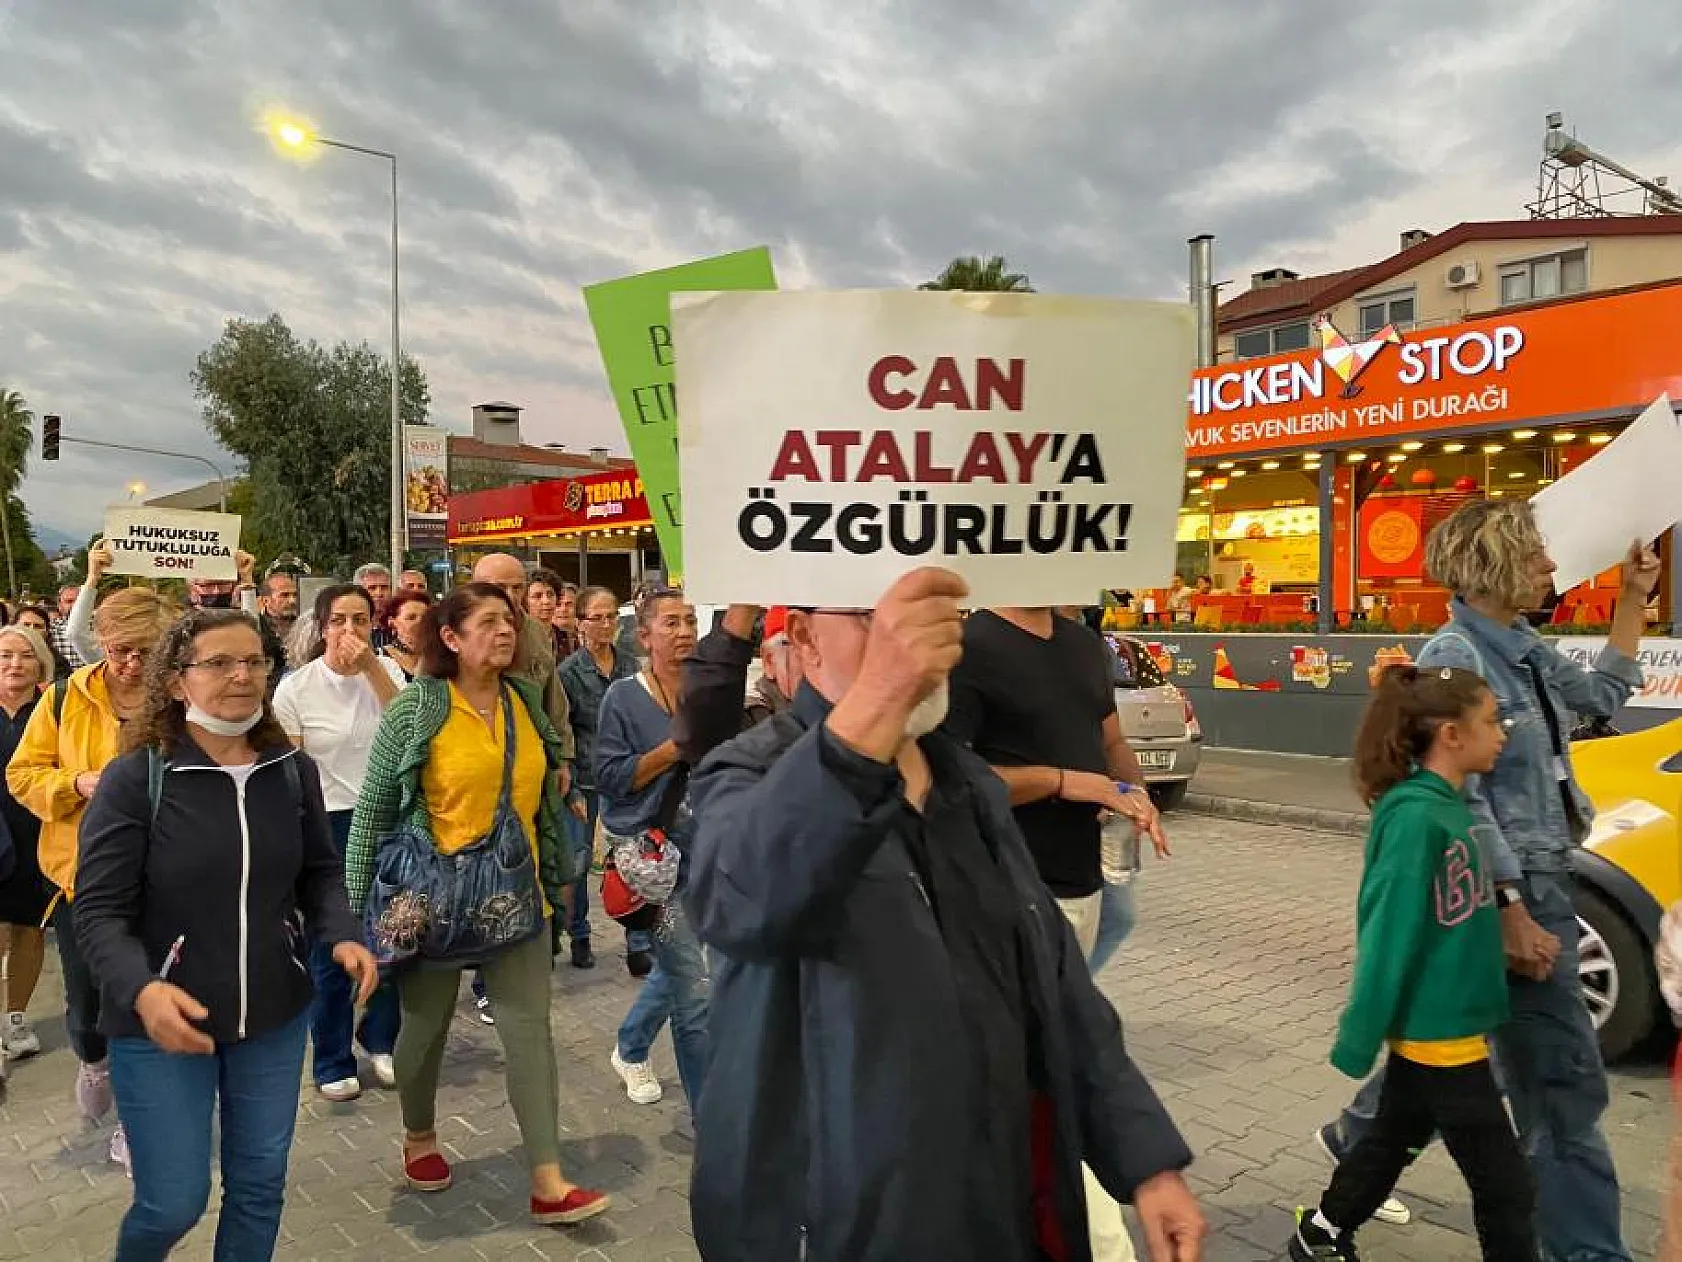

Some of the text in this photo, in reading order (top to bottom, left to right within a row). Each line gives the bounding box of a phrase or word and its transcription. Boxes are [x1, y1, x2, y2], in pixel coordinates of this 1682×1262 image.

[868, 355, 1025, 411] CAN
[1187, 326, 1523, 415] HICKEN STOP
[1230, 406, 1347, 443] SEVENLERİN
[1354, 397, 1404, 427] YENİ
[1412, 384, 1508, 420] DURAĞI
[768, 430, 1106, 484] ATALAY'A
[128, 525, 220, 542] HUKUKSUZ
[738, 487, 1132, 556] ÖZGÜRLÜK!
[154, 556, 194, 569] SON!
